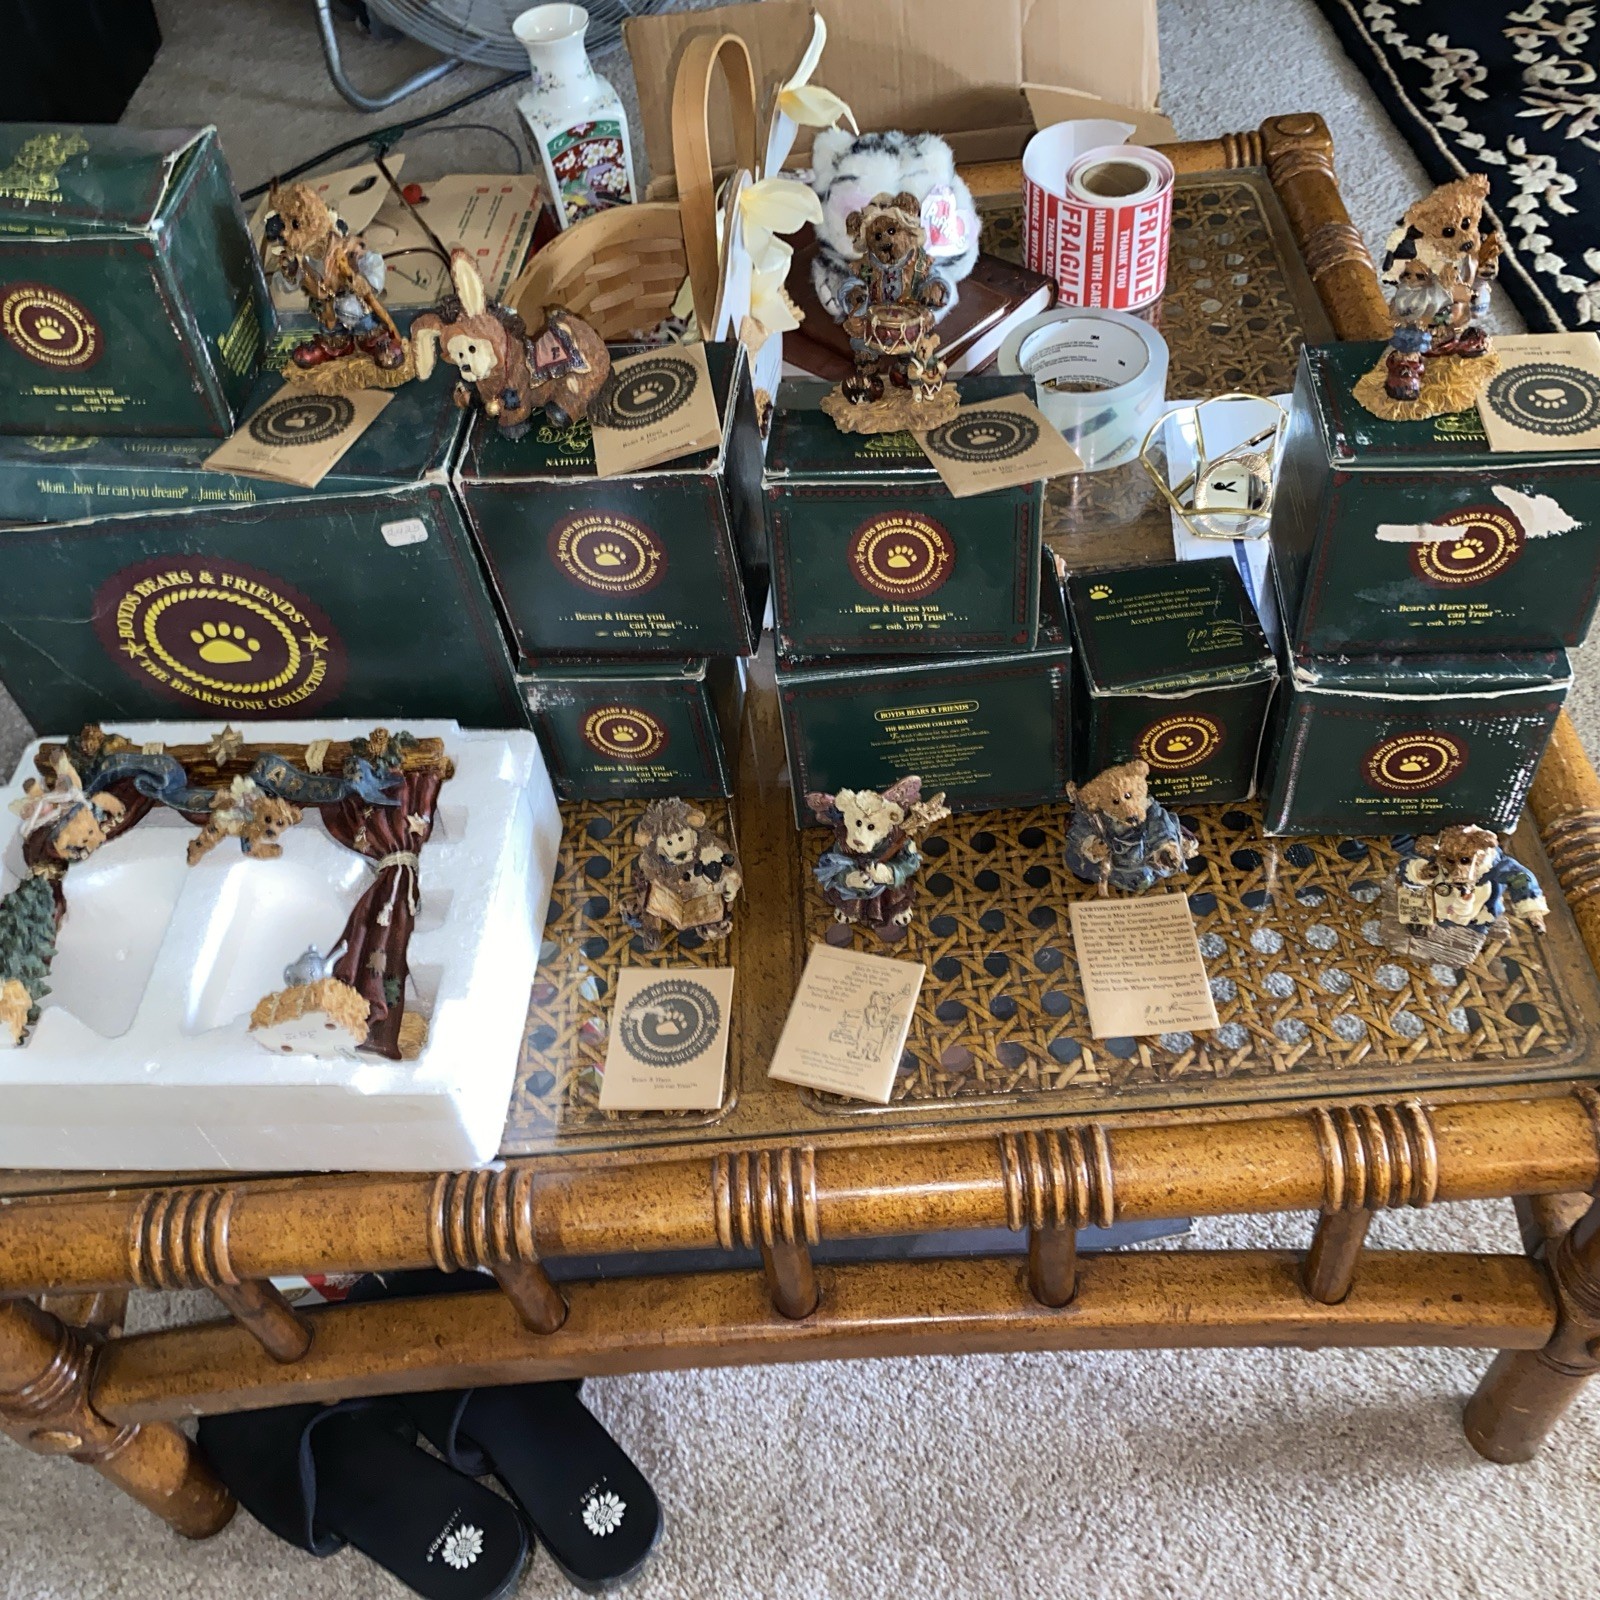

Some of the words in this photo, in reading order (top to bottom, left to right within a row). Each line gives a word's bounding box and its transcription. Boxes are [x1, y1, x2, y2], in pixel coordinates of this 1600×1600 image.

[1047, 217, 1055, 254] THANK
[1092, 209, 1106, 253] HANDLE
[1058, 204, 1082, 305] FRAGILE
[1118, 228, 1130, 268] THANK
[1134, 202, 1159, 302] FRAGILE
[1046, 256, 1054, 277] YOU
[1091, 253, 1104, 282] WITH
[1116, 268, 1127, 289] YOU
[96, 387, 115, 398] you
[1433, 434, 1488, 442] NATIVITY
[854, 450, 902, 459] NATIVITY
[545, 457, 592, 467] NATIVITY
[97, 482, 110, 496] far
[112, 486, 129, 497] can
[131, 486, 149, 500] you
[229, 487, 257, 502] Smith
[1450, 512, 1482, 526] BEARS
[558, 526, 574, 551] BOYDS
[573, 515, 602, 530] BEARS
[604, 516, 612, 525] &
[857, 528, 877, 553] BOYDS
[875, 517, 903, 531] BEARS
[905, 518, 913, 526] &
[116, 591, 141, 640] BOYDS
[134, 569, 194, 598] BEARS
[199, 569, 216, 585] &
[882, 605, 891, 613] &
[892, 604, 919, 613] Hares
[921, 604, 939, 615] you
[1438, 603, 1468, 611] Hares
[1469, 603, 1489, 613] you
[604, 612, 613, 621] &
[615, 611, 644, 621] Hares
[647, 613, 666, 624] you
[903, 613, 920, 622] can
[1130, 617, 1154, 625] Accept
[1447, 611, 1465, 619] can
[629, 621, 647, 629] can
[905, 622, 924, 631] 1979
[634, 631, 652, 639] 1979
[140, 659, 170, 682] THE
[169, 678, 267, 711] BEARSTONE
[880, 710, 906, 720] BOYDS
[906, 708, 930, 718] BEARS
[930, 706, 937, 714] &
[1397, 735, 1427, 745] BEARS
